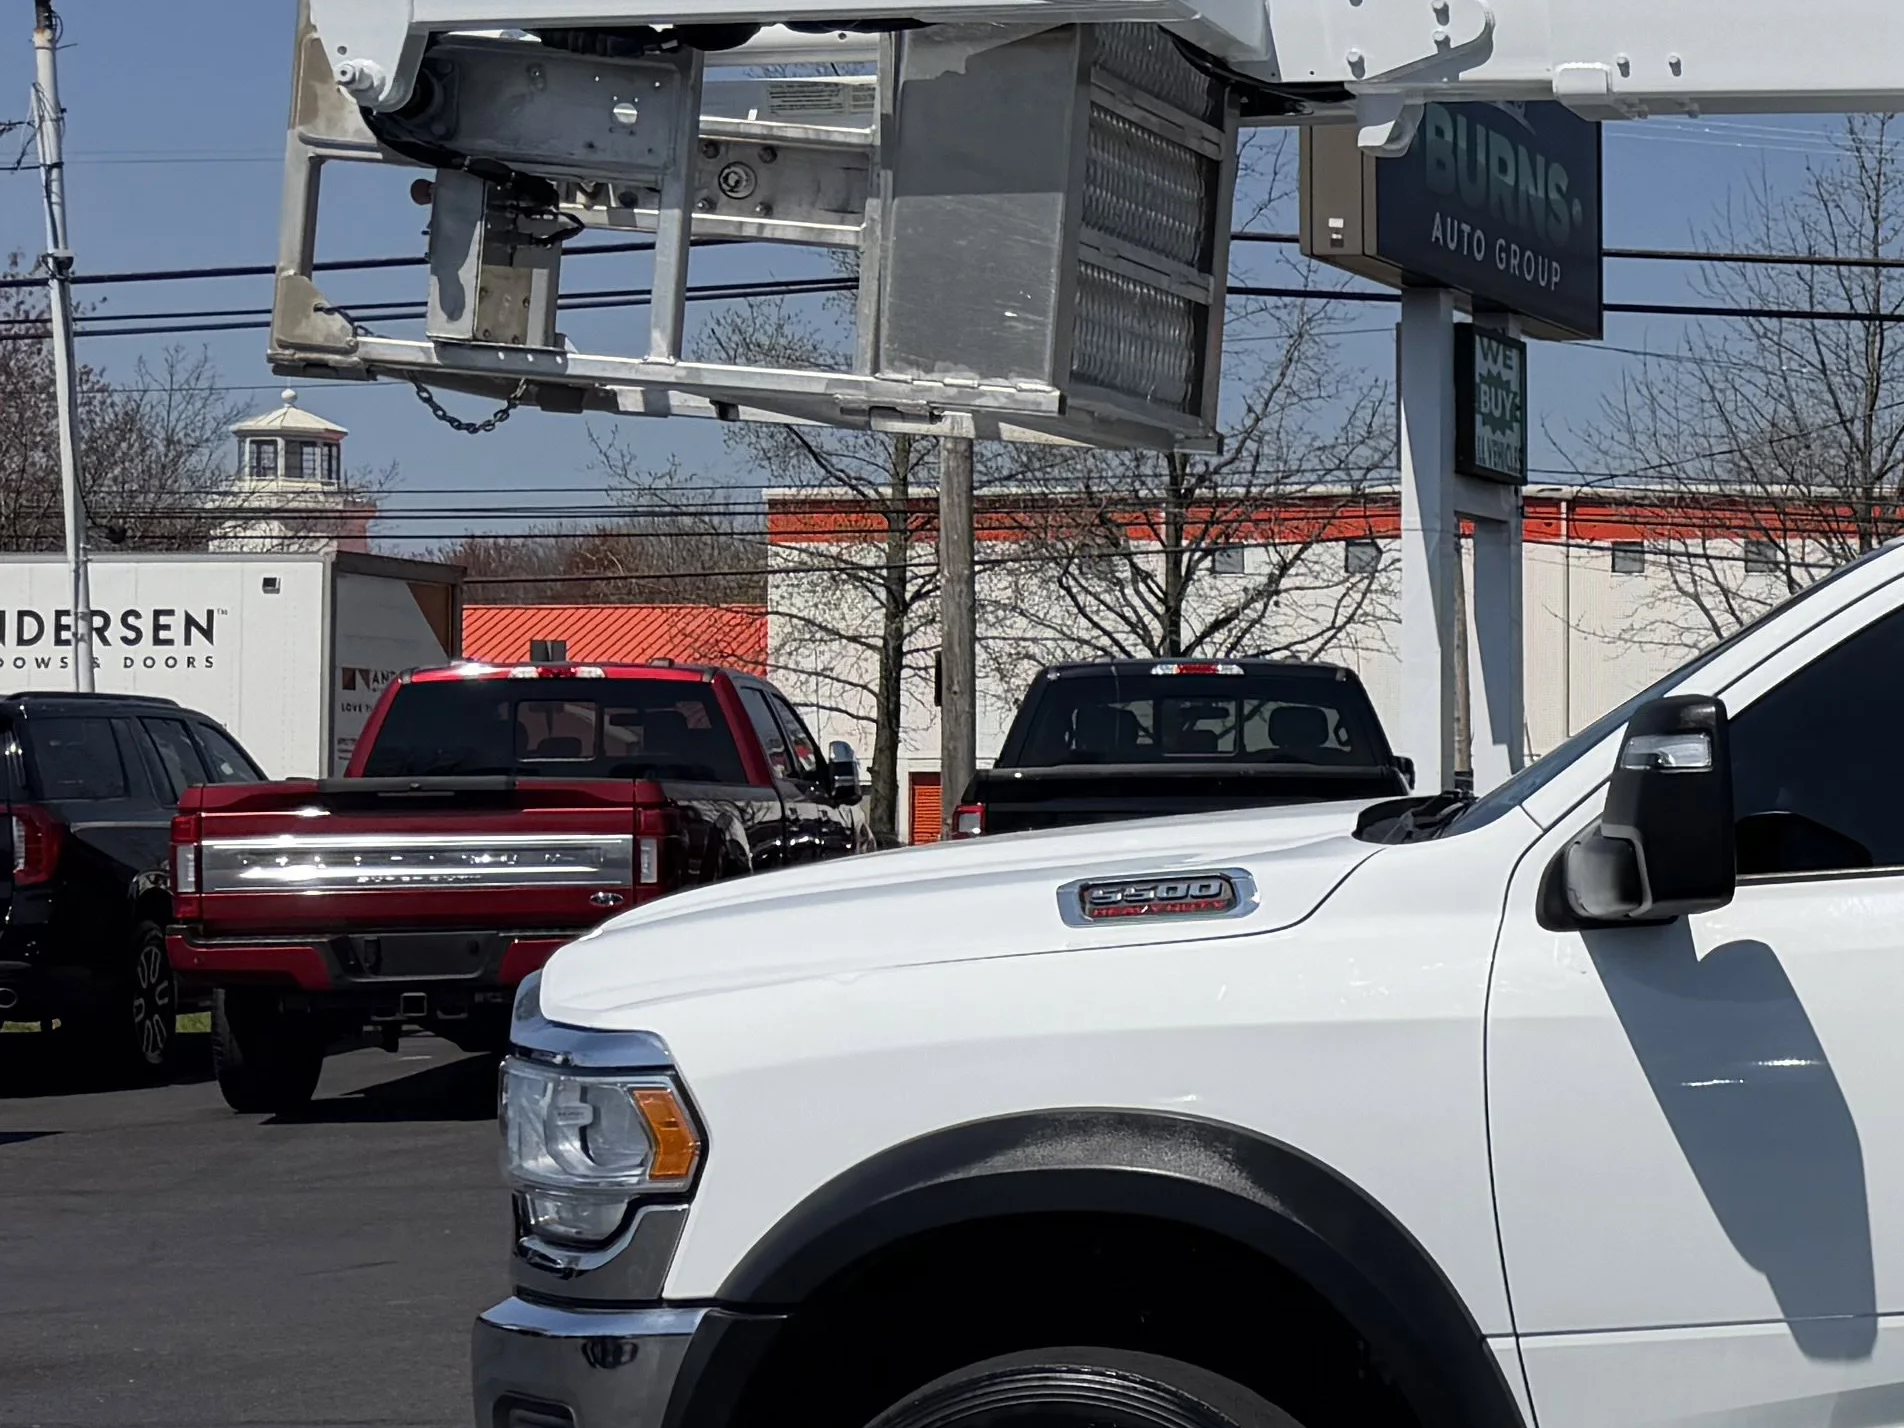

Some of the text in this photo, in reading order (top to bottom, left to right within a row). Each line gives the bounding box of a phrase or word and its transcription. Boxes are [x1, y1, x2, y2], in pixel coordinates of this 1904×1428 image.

[1425, 102, 1570, 246] BURNS
[1431, 211, 1562, 291] AUTO GROUP
[1480, 335, 1514, 370] WE
[1480, 383, 1514, 421] BUY
[0, 608, 215, 647] DERSEN
[123, 656, 214, 669] DOORS
[1090, 882, 1223, 906] 5500
